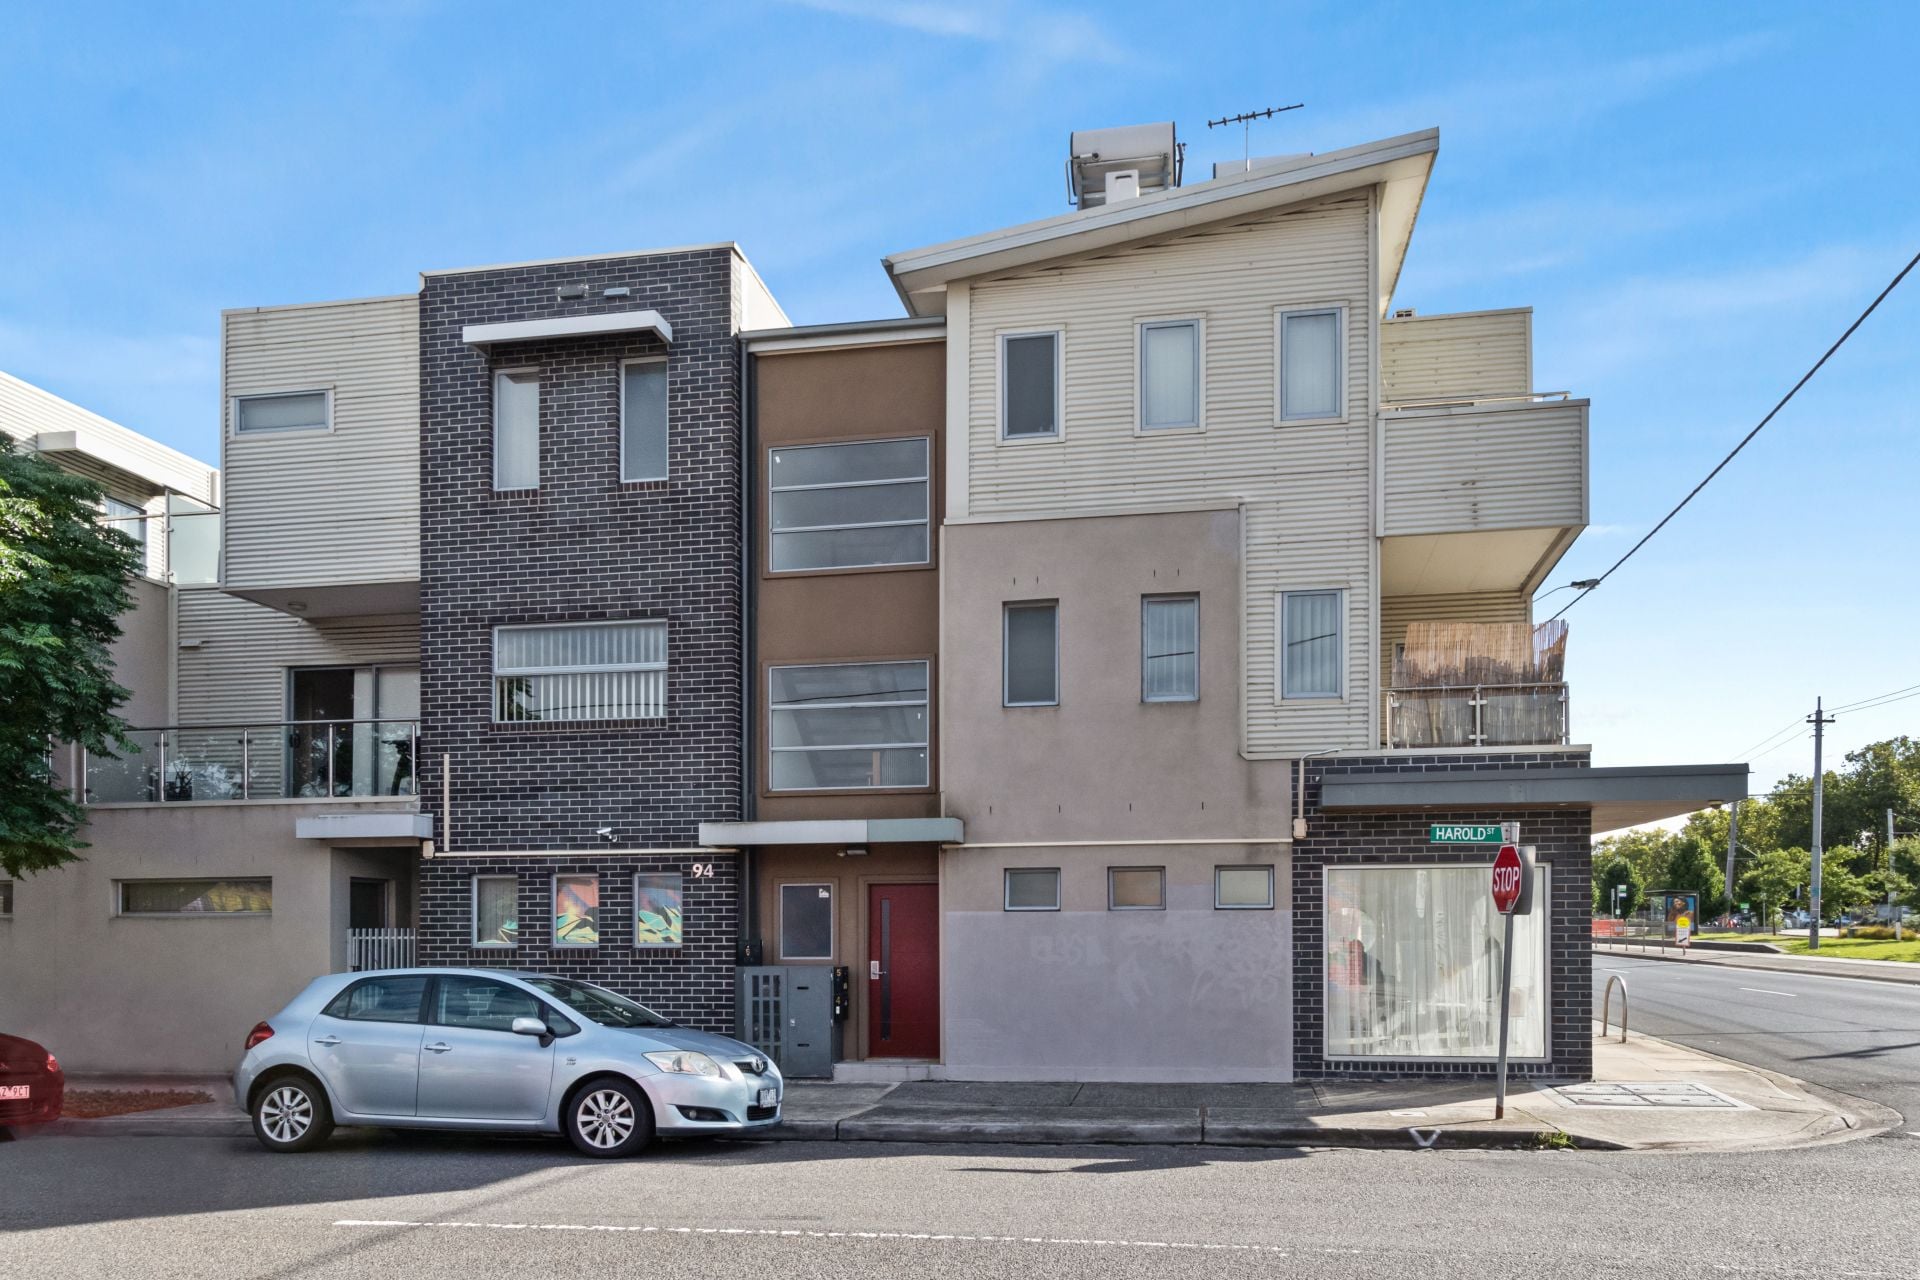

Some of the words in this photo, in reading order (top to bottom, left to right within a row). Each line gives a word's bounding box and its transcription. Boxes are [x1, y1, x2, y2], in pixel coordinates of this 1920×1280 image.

[1436, 828, 1486, 840] HAROLD
[692, 863, 714, 878] 94
[1494, 867, 1519, 891] STOP
